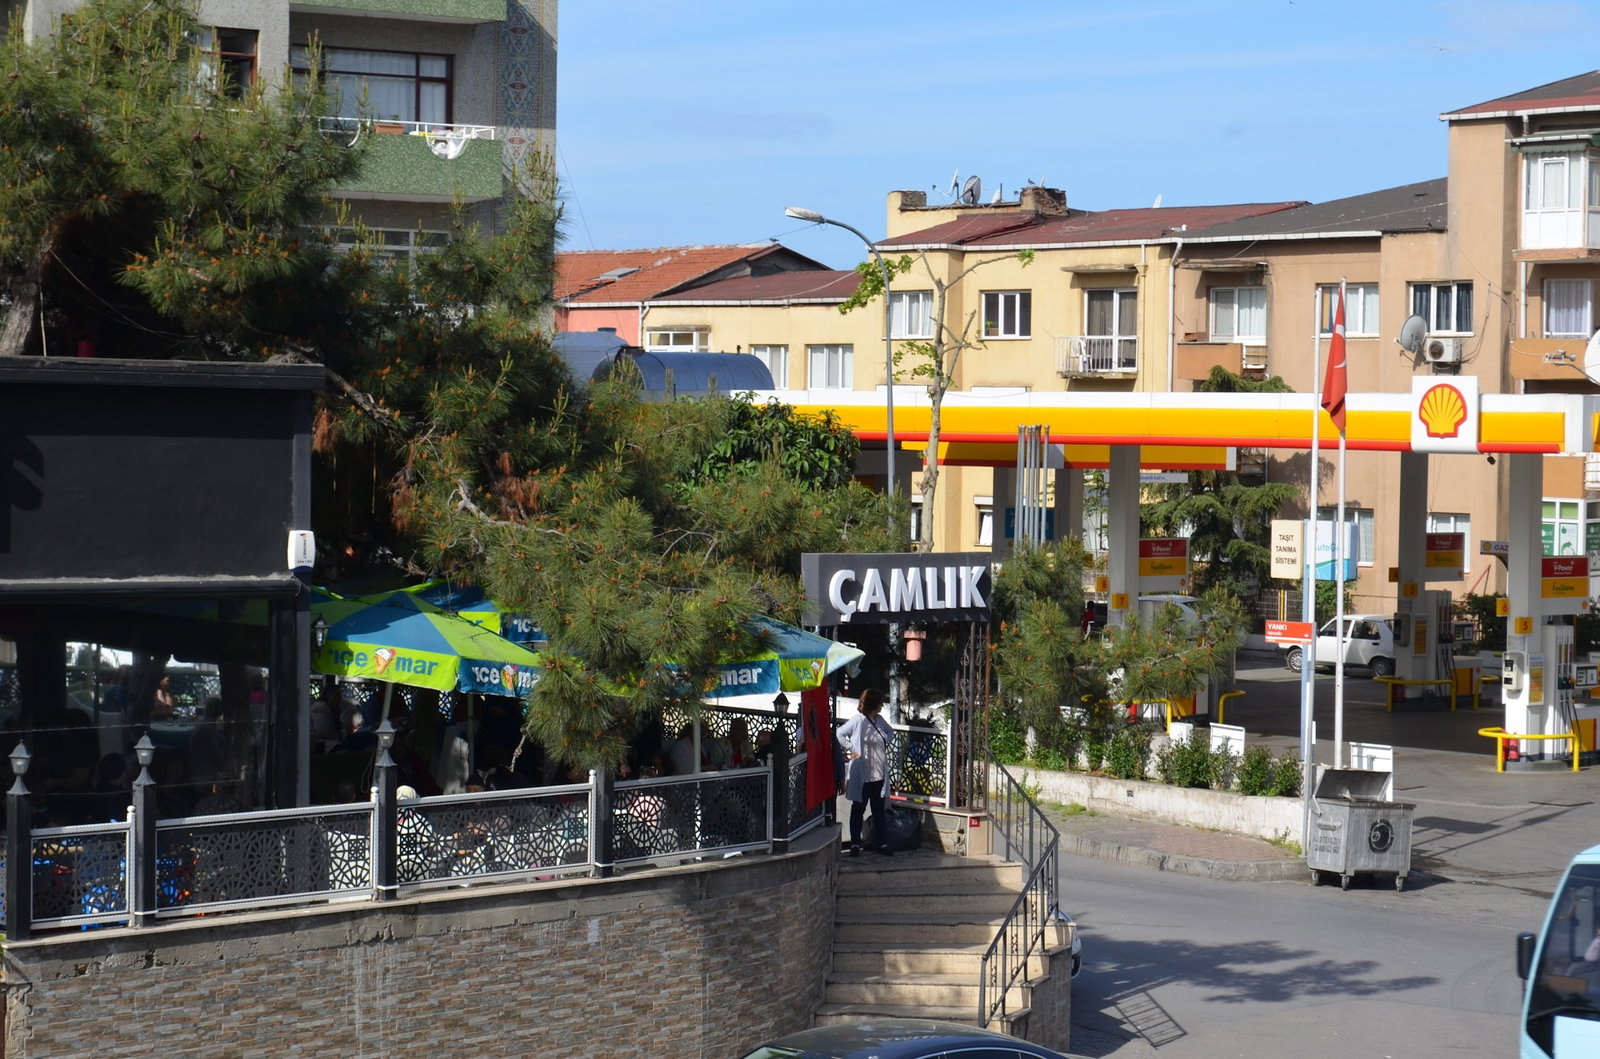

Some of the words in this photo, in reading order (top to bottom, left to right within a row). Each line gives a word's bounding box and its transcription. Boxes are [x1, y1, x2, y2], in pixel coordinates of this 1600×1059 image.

[1279, 534, 1294, 542] TAŞIT
[1275, 545, 1297, 553] TANIMA
[1275, 557, 1297, 565] SİSTEMİ
[828, 565, 987, 623] ÇAMLIK
[395, 656, 438, 676] mar
[720, 667, 763, 686] mar
